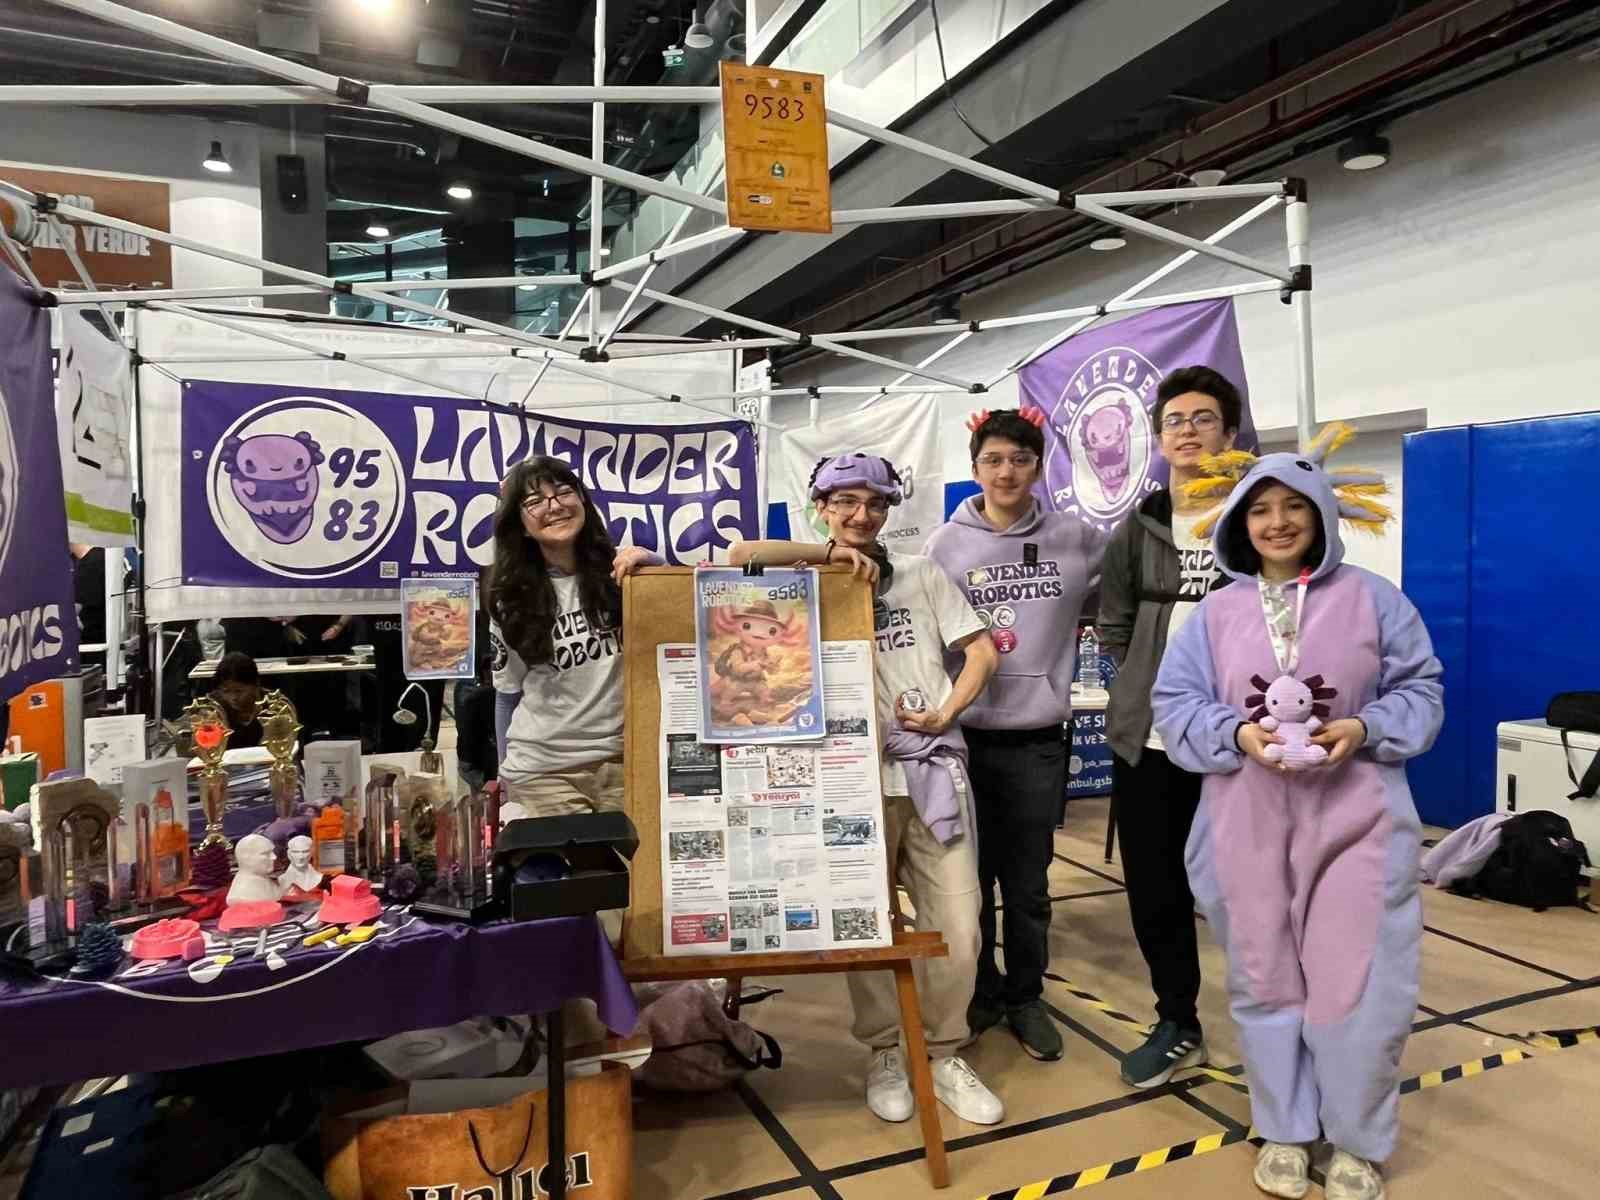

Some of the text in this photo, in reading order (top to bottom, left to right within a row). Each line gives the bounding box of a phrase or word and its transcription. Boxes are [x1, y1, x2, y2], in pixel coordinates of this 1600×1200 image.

[744, 94, 805, 122] 9583
[1056, 355, 1158, 436] LAVENDE
[329, 447, 381, 489] 95
[412, 405, 742, 495] LAVENDER
[323, 499, 380, 541] 83
[410, 490, 743, 567] ROTICS
[966, 560, 1061, 587] LVENDER
[968, 580, 1064, 607] ROBOTICS
